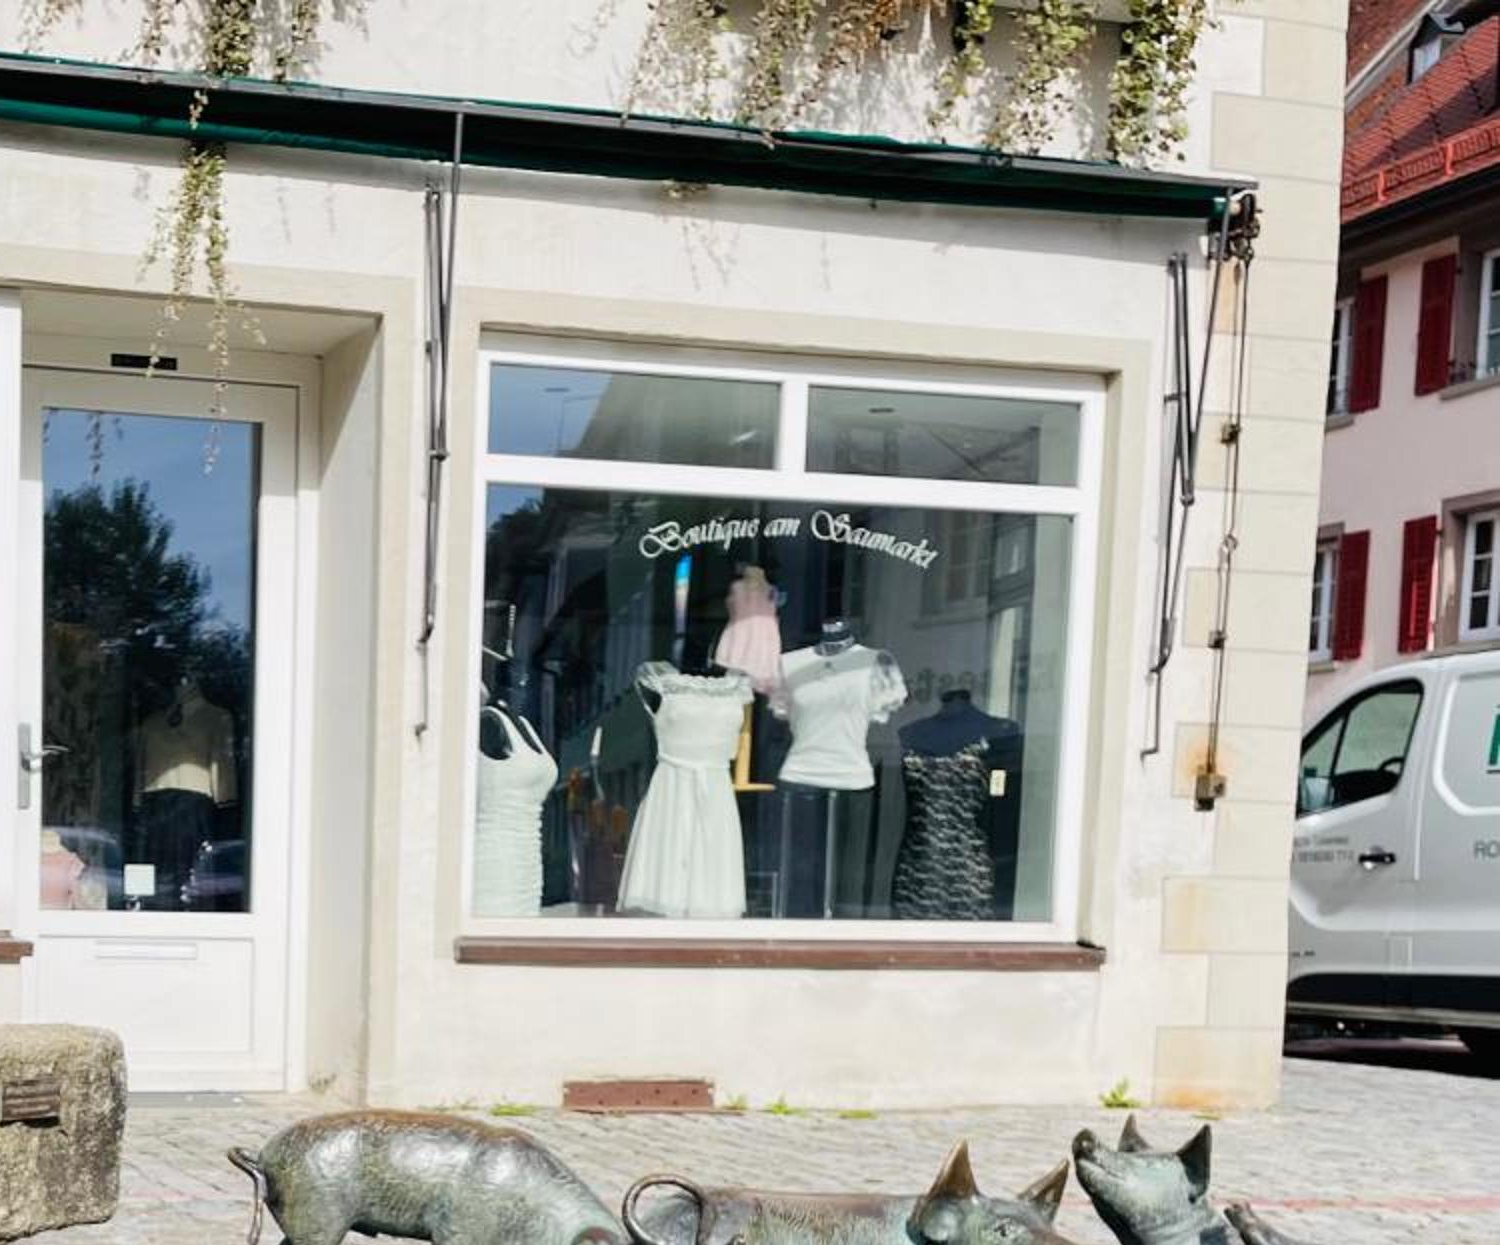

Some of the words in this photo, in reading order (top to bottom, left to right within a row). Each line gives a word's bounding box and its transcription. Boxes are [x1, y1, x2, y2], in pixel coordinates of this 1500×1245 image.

[639, 517, 761, 558] Boutique
[763, 517, 802, 537] am
[811, 510, 939, 569] Saumarkt
